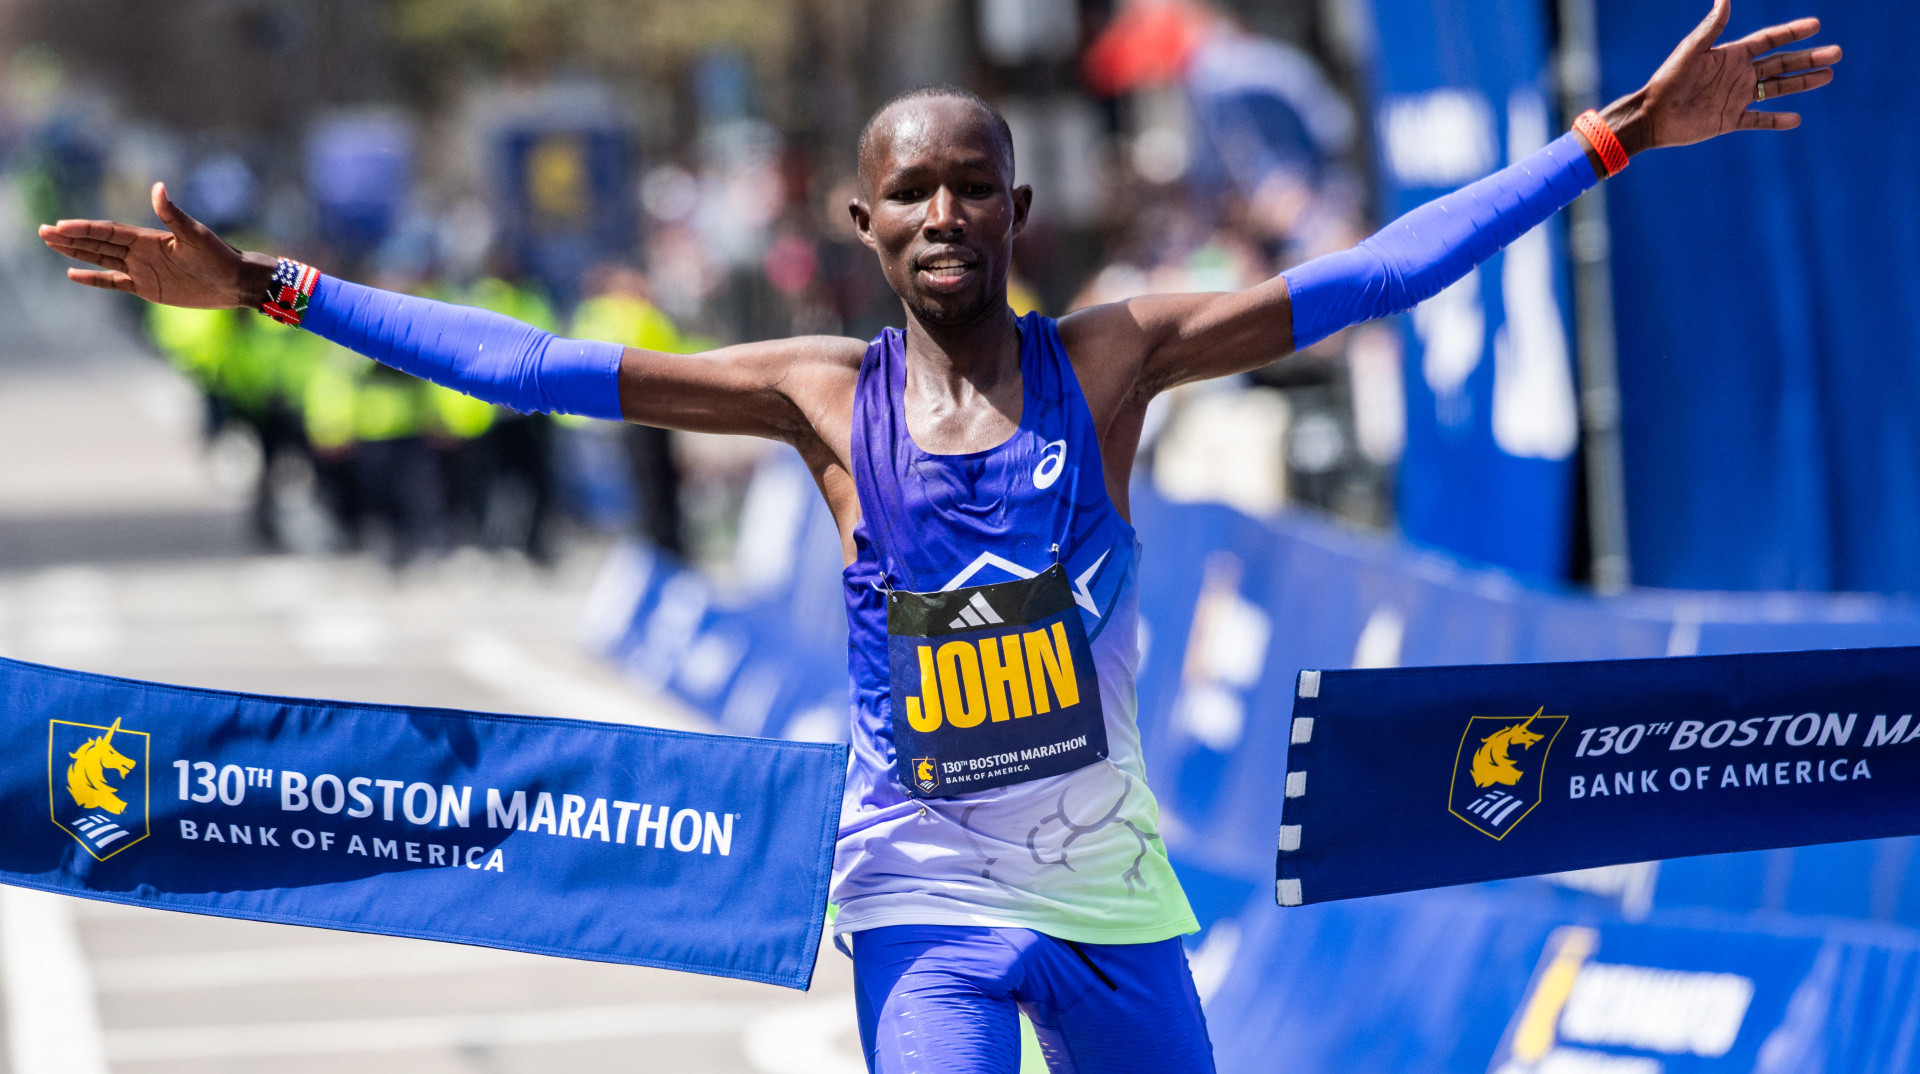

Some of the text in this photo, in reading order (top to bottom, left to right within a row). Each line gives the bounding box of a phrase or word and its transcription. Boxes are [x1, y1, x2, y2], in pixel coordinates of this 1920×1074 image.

[905, 620, 1080, 733] JOHN
[941, 736, 1087, 773] 130TH BOSTON MARATHON
[1575, 721, 1673, 758] 130TH
[1668, 712, 1858, 751] BOSTON
[945, 764, 1030, 784] BANK OF AMERICA
[1569, 758, 1872, 799] BANK OF AMERICA
[172, 759, 734, 857] 130TH BOSTON MARATHON
[179, 819, 505, 873] BANK OF AMERICA
